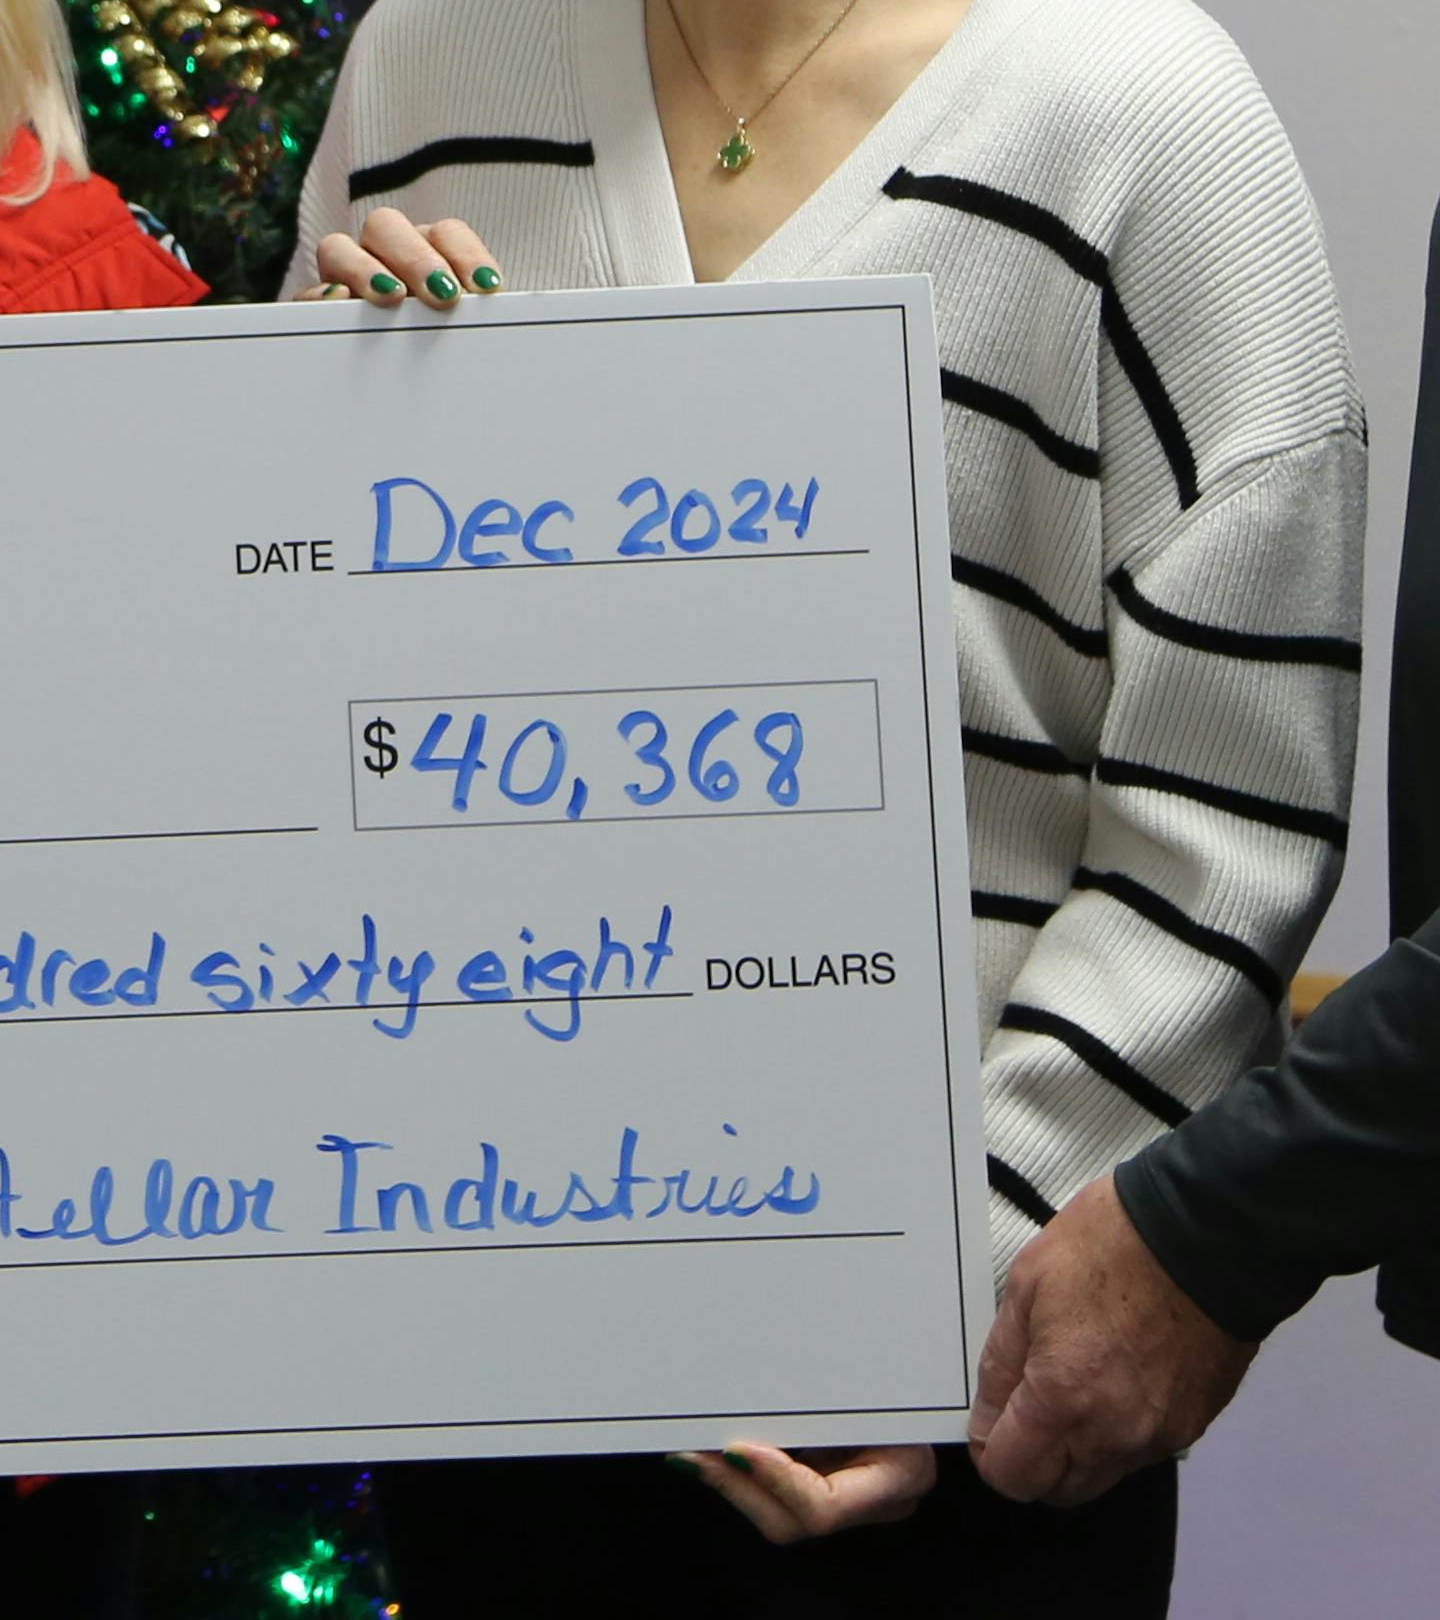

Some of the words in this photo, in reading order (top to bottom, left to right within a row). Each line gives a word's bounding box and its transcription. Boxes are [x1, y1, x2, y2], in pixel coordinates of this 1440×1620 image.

[235, 541, 335, 576] DATE
[370, 476, 578, 571] Dec
[616, 476, 824, 558] 2024
[189, 913, 438, 1041] sixty
[456, 905, 676, 1044] eight
[706, 951, 898, 993] DOLLARS
[315, 1123, 824, 1236] Industries
